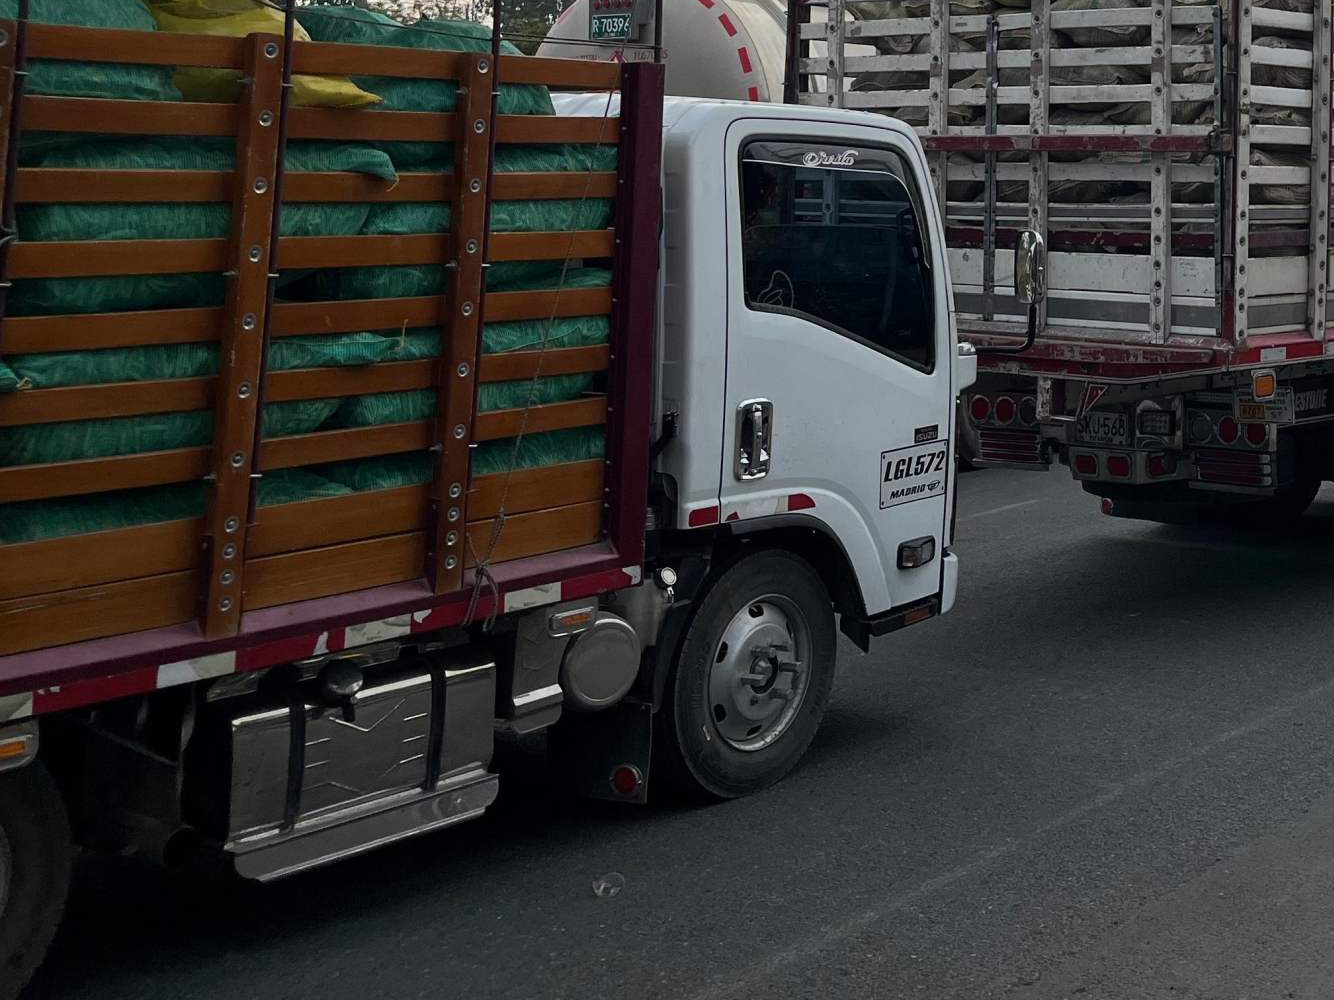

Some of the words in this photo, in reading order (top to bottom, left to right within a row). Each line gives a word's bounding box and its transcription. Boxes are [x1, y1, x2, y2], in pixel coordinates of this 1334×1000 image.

[1295, 388, 1328, 413] ESTONE
[916, 430, 938, 442] ISUZU
[883, 450, 946, 483] LGL572
[890, 484, 927, 500] MADRID
